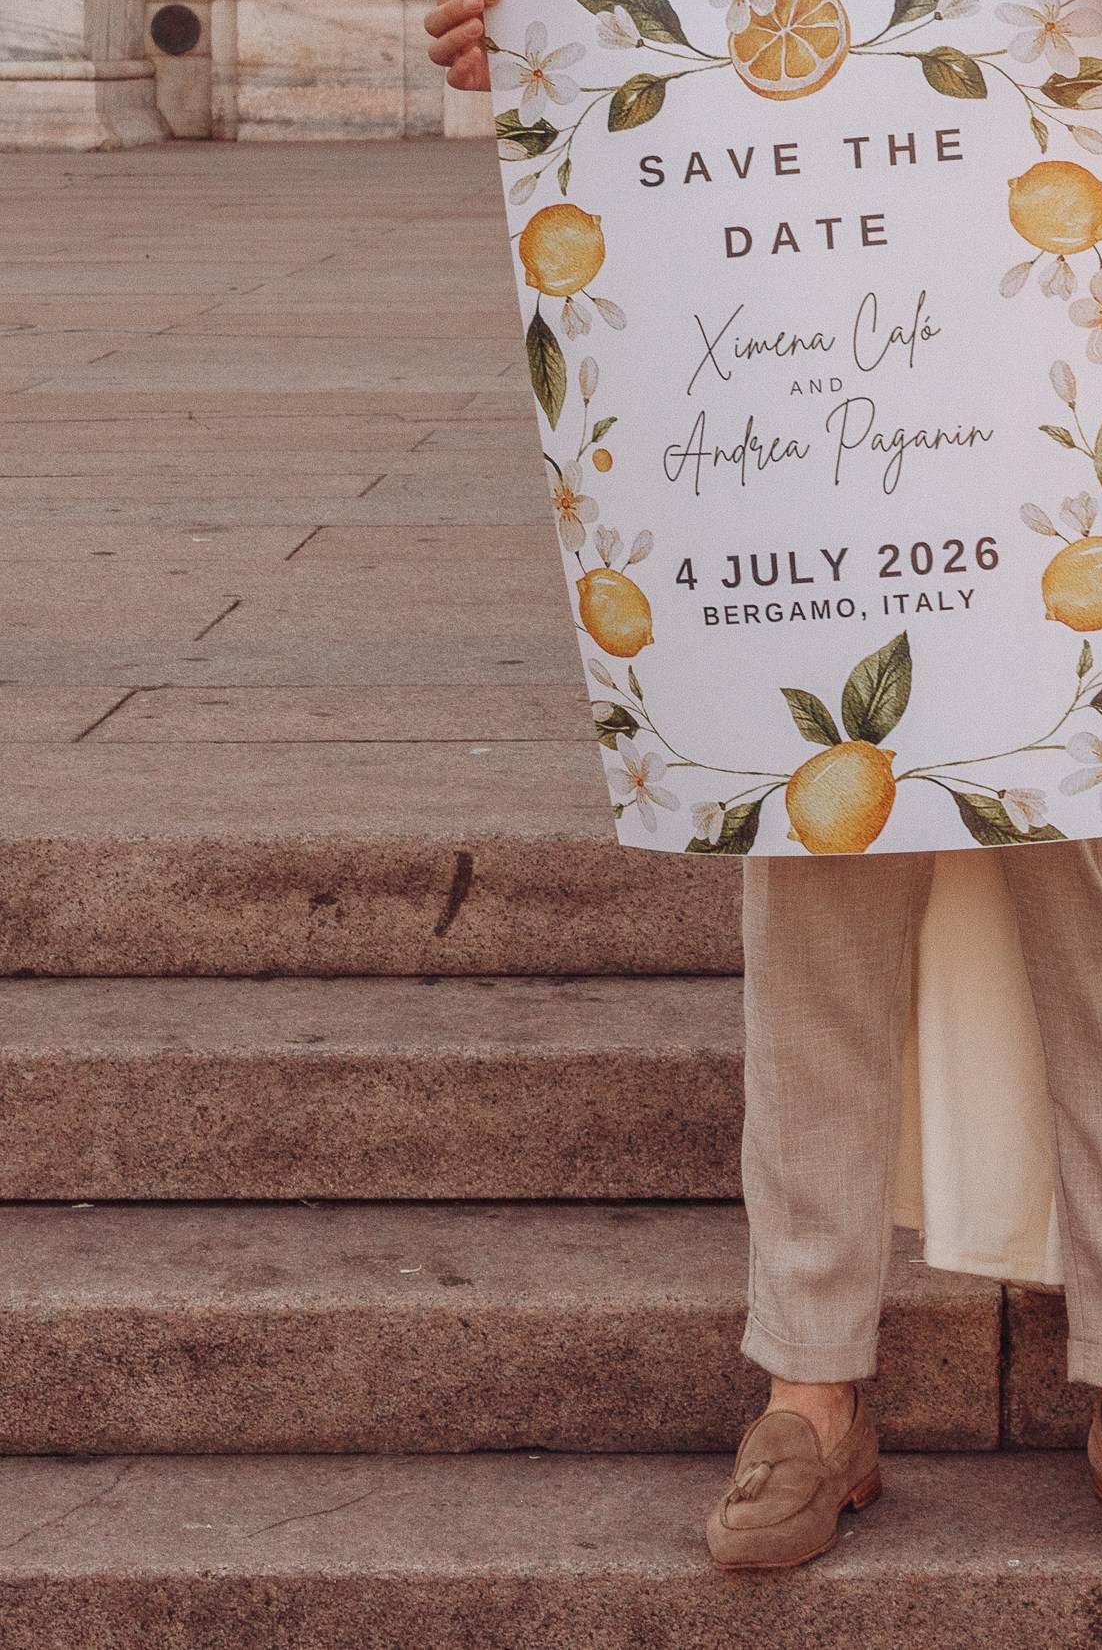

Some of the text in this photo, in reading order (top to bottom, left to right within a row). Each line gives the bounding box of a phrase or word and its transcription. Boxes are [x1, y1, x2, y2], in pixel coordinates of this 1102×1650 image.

[638, 128, 964, 188] SAVE THE
[723, 213, 888, 259] DATE
[686, 289, 942, 397] Ximena Caló
[789, 377, 843, 396] AND
[663, 395, 994, 497] Andrea Paganin
[675, 536, 1000, 591] 4 JULY 2026
[702, 588, 975, 628] BERGAMO, ITALY
